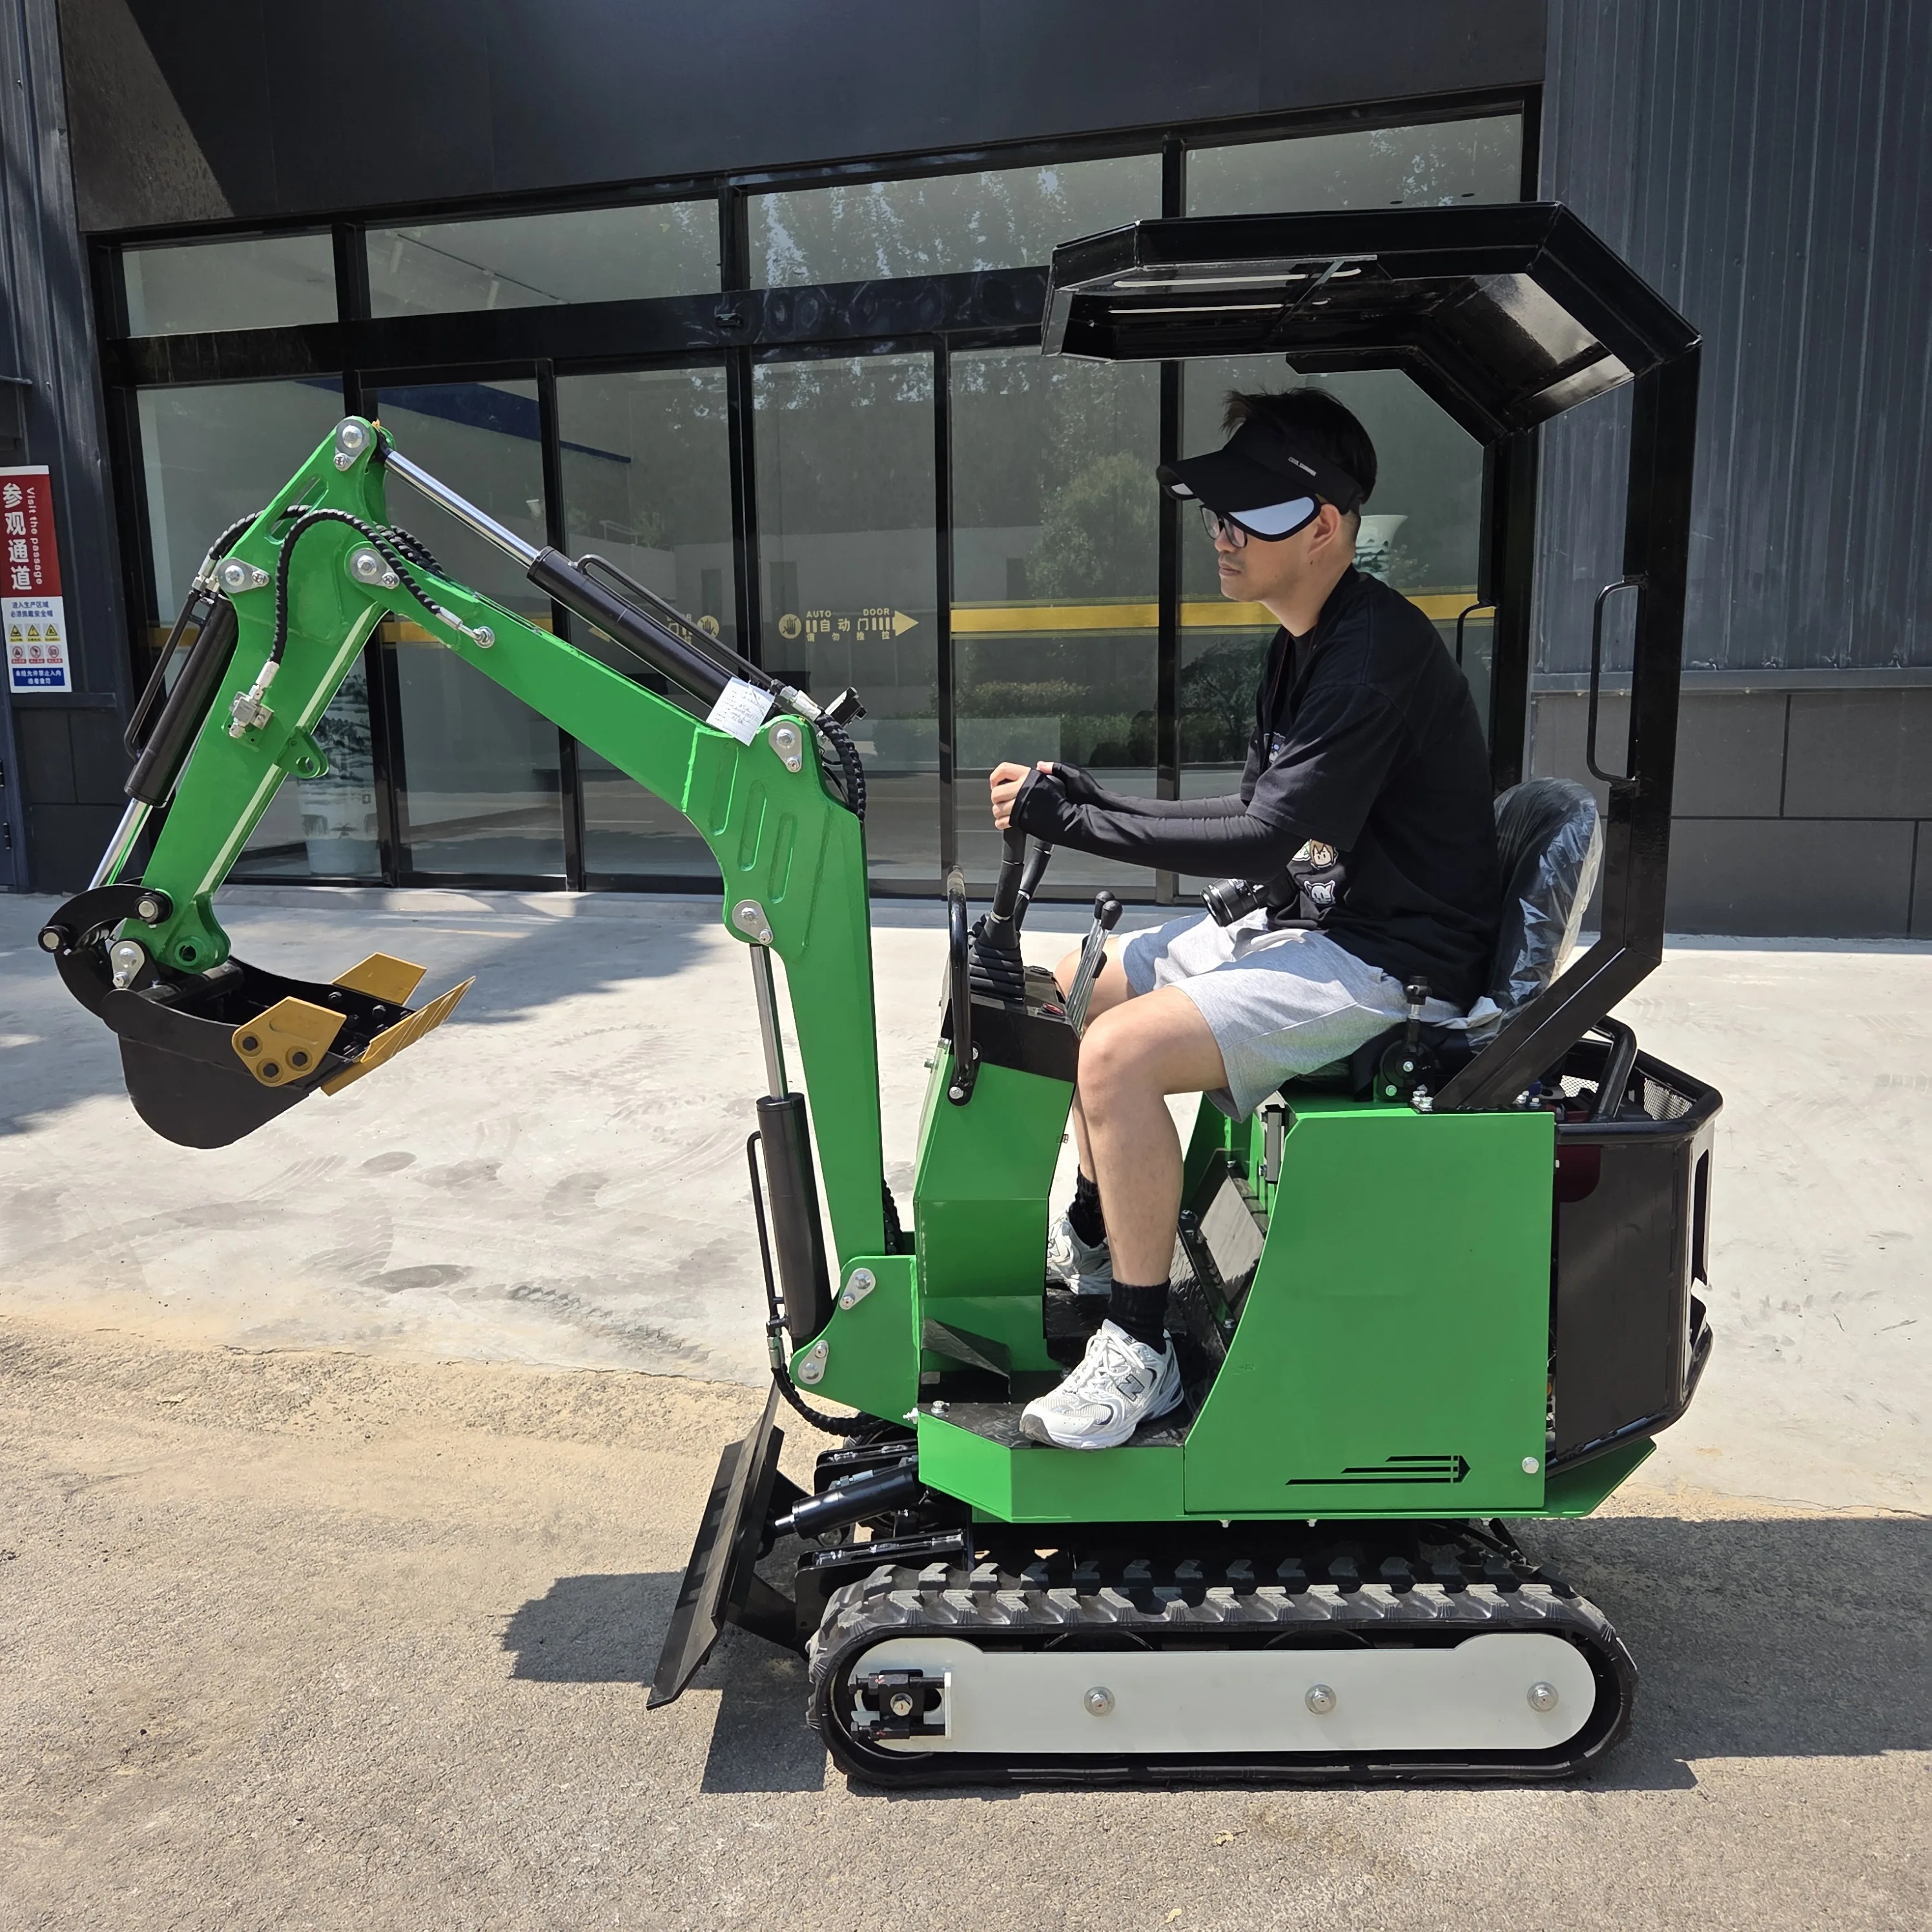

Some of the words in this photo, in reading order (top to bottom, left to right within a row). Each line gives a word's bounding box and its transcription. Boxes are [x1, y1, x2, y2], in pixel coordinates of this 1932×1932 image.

[26, 487, 37, 513] Visit
[30, 517, 38, 534] the
[3, 482, 32, 590] 参观通道
[30, 538, 43, 584] passage
[806, 610, 832, 619] AUTO
[862, 608, 890, 617] DOOR
[820, 617, 869, 633] 自动门
[807, 631, 890, 642] 请勿推拉
